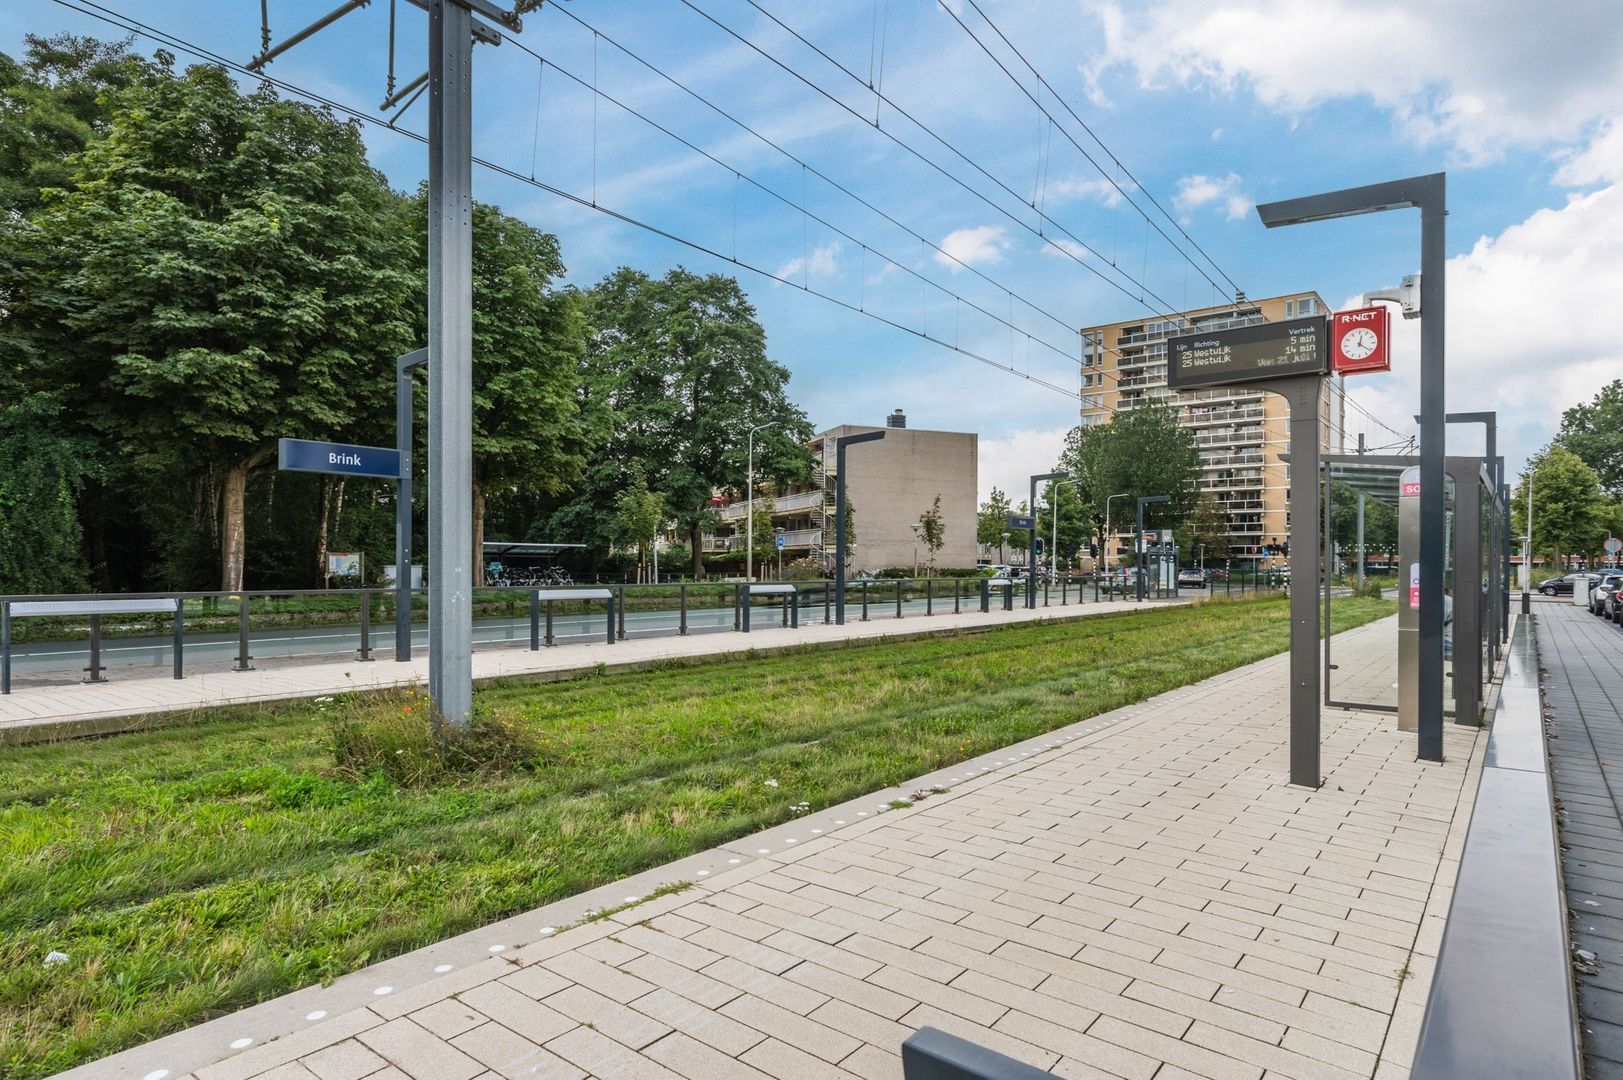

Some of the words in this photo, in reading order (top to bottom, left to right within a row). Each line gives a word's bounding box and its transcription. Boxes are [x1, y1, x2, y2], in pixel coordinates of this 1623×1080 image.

[1342, 311, 1377, 323] R-NET
[1194, 340, 1220, 348] Richting
[1289, 326, 1316, 335] Vertrek
[1182, 351, 1193, 359] 25
[1194, 346, 1231, 357] Westwijk
[1290, 336, 1297, 344] 5
[1300, 335, 1316, 343] min
[1182, 359, 1193, 367] 25
[1194, 355, 1231, 366] Westwijk
[1285, 345, 1296, 354] 14
[1300, 344, 1316, 352] min
[329, 452, 361, 466] Brink
[1406, 485, 1420, 493] SO
